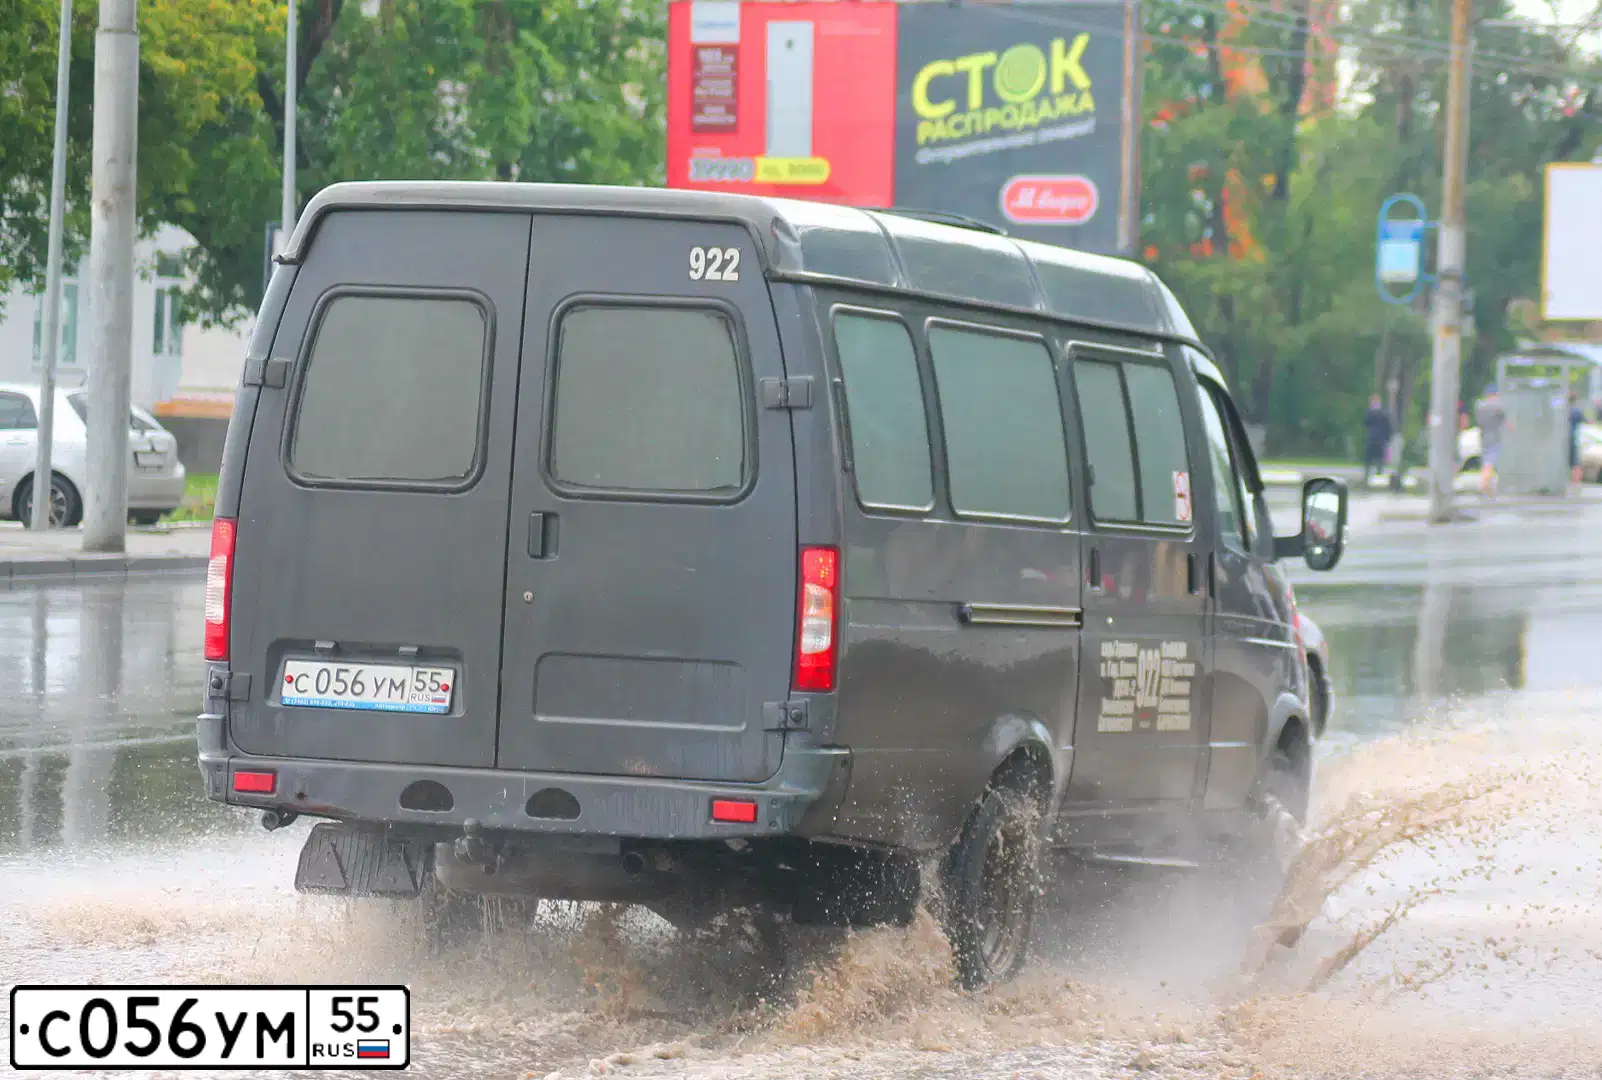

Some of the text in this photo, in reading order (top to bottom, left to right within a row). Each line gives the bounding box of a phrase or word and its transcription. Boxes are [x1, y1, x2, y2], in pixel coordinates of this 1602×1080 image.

[912, 32, 1091, 119] СТОК
[916, 88, 1096, 145] РАСПРОДАЖА
[689, 246, 740, 281] 922
[410, 693, 431, 702] RUS
[414, 670, 442, 692] 55
